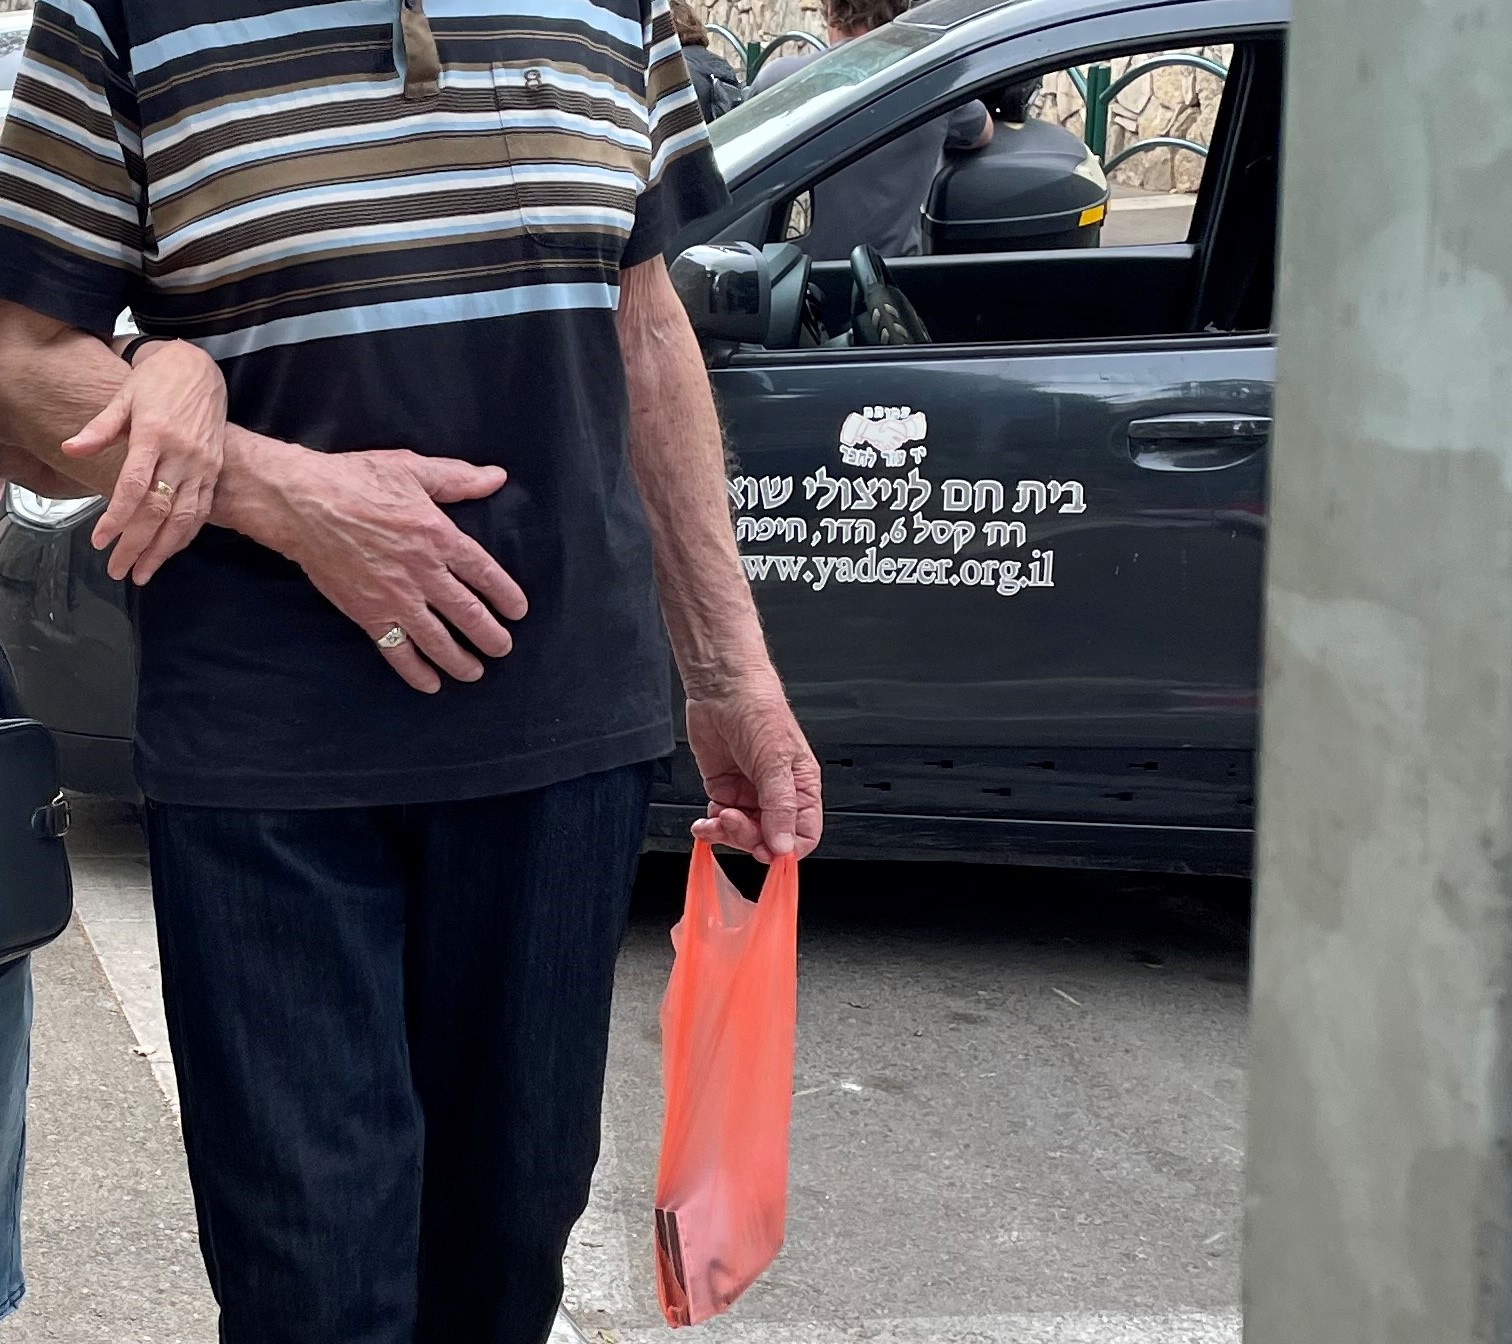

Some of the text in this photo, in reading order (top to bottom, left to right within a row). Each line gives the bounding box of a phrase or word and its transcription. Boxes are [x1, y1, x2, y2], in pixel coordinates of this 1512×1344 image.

[839, 444, 927, 469] יד עזר לחבר
[725, 465, 1088, 515] בית חם לניצולי שוא
[736, 516, 808, 543] חיפה
[810, 516, 876, 547] הדר,
[913, 511, 976, 555] קסל
[738, 546, 1056, 597] ww.yadezer.org.il
